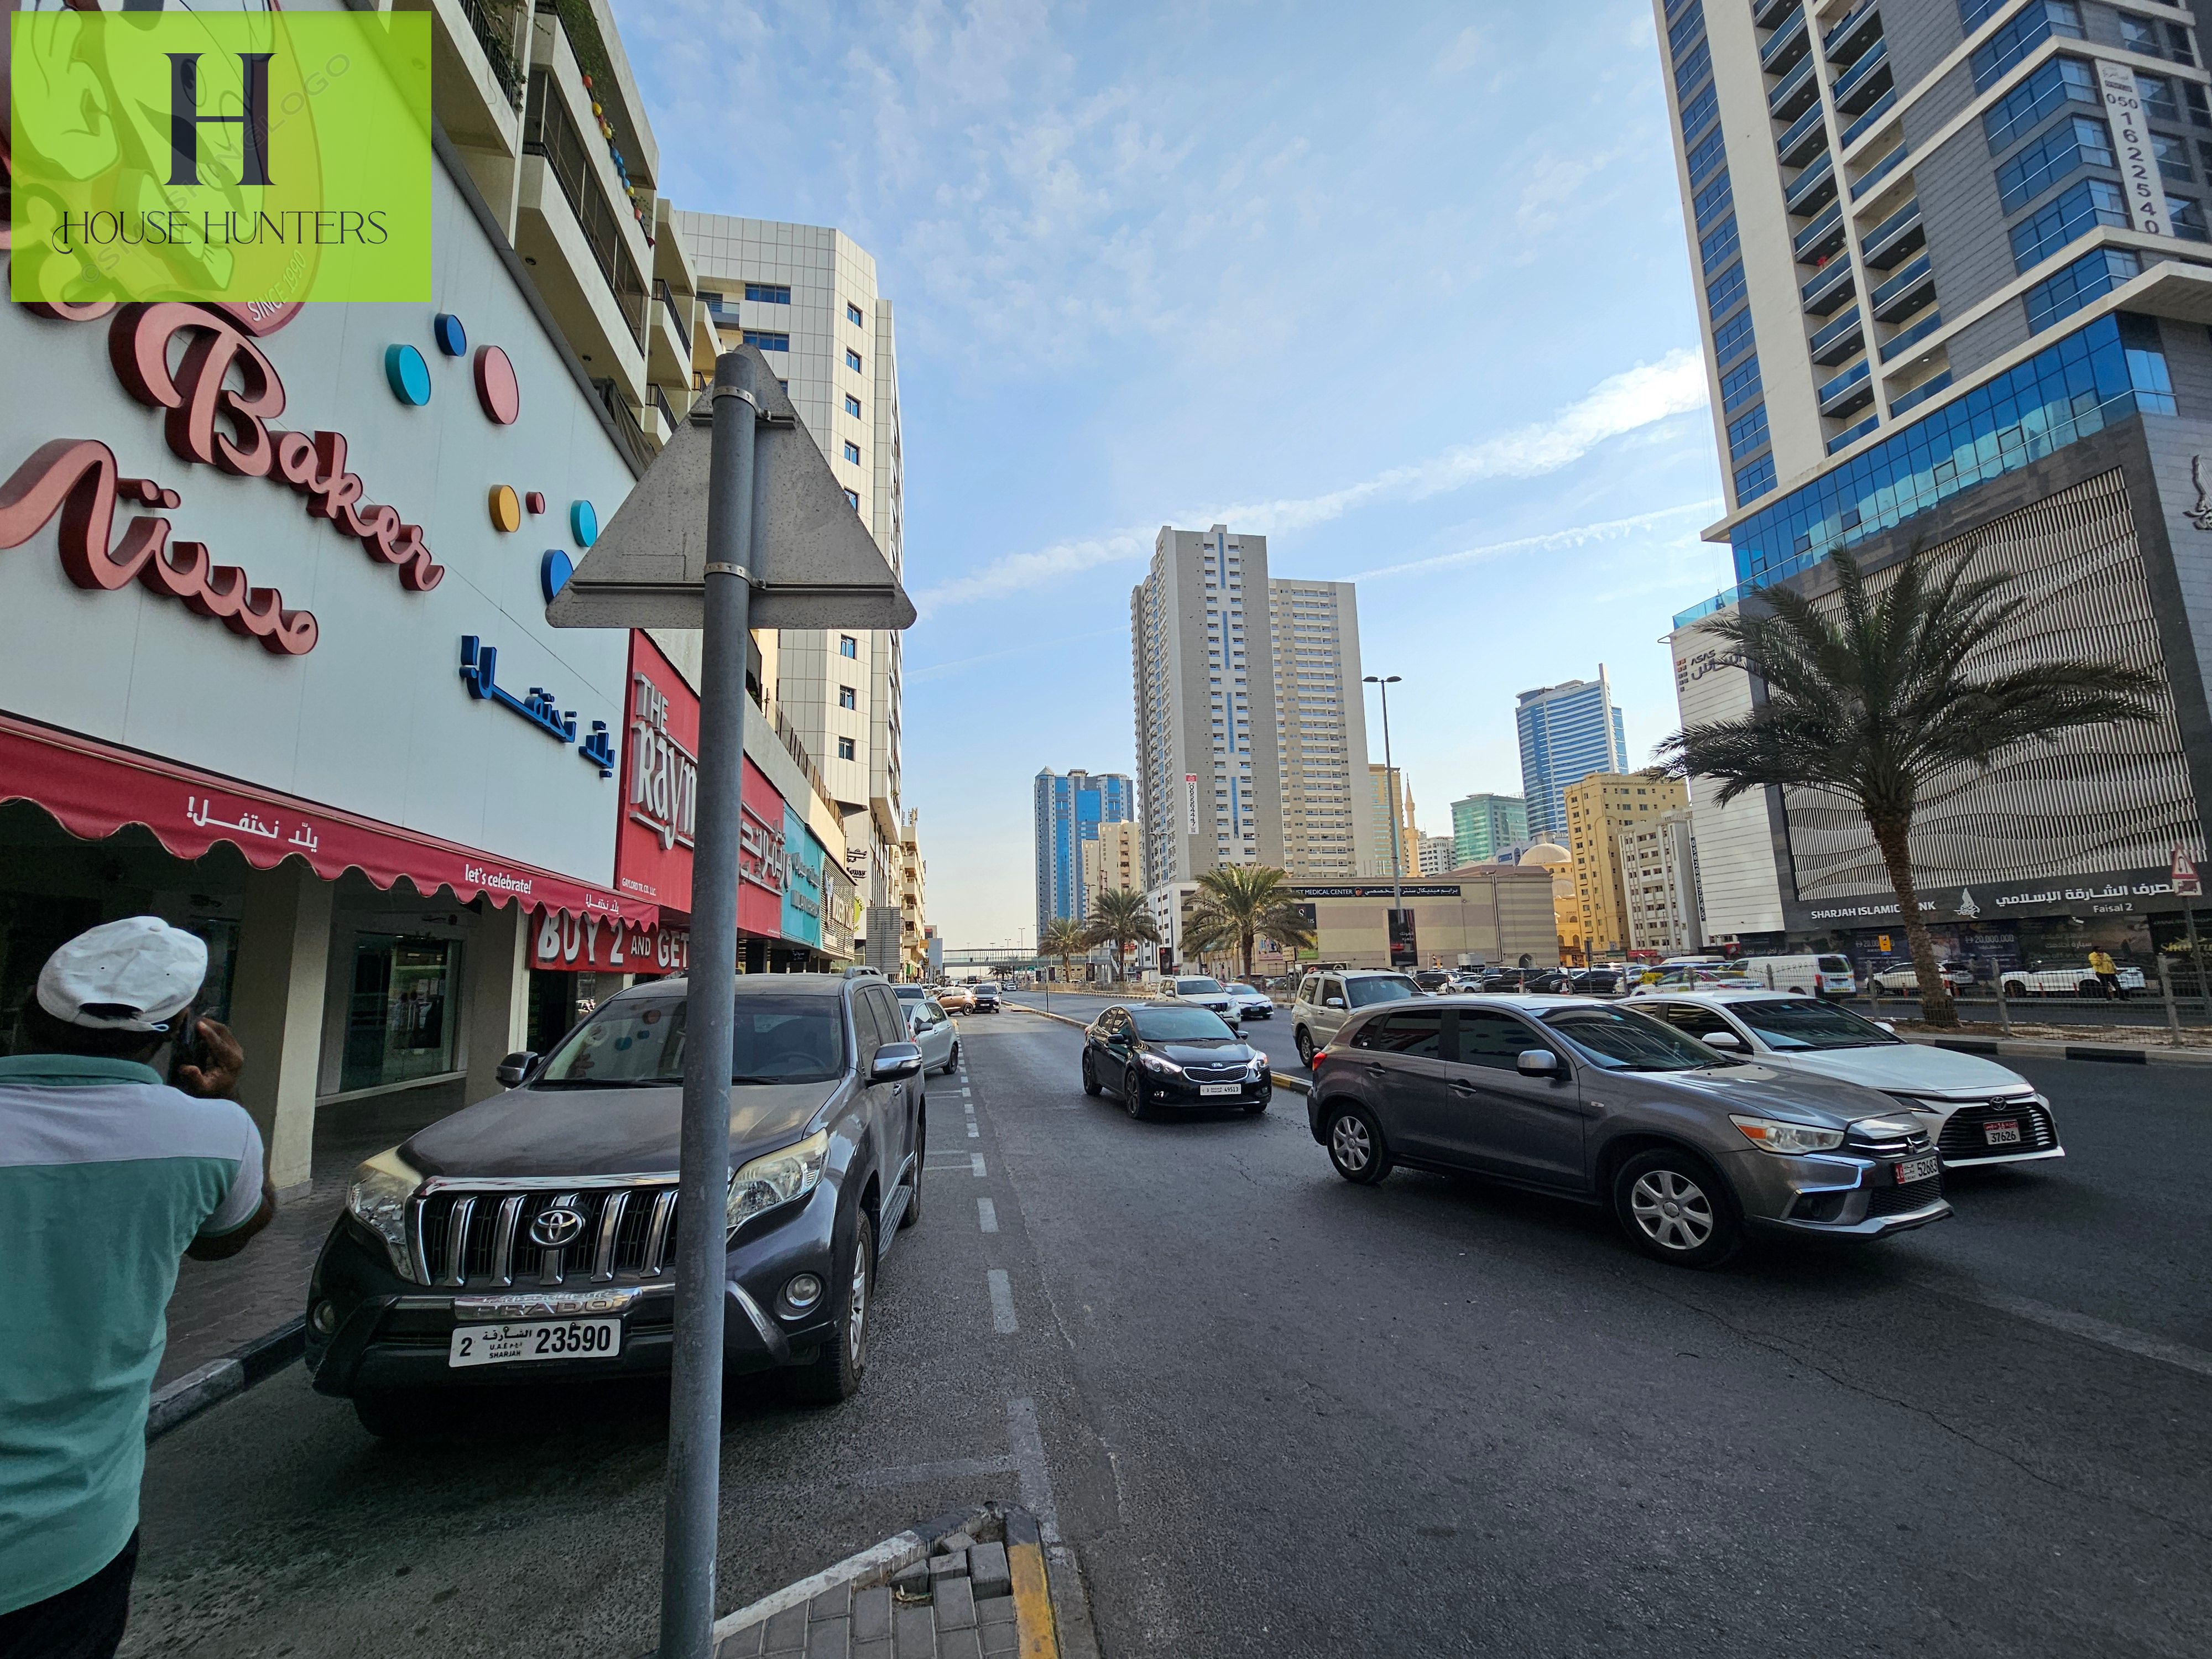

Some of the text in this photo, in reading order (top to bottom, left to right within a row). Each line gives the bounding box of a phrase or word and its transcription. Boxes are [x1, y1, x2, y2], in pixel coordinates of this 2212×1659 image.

[2106, 93, 2138, 109] 050
[247, 248, 306, 322] SINCE 1990
[109, 302, 445, 591] Baker
[634, 671, 669, 735] THE
[465, 863, 532, 895] let's celebrate!
[2065, 883, 2128, 901] الشارقة
[2132, 883, 2174, 896] صرف
[1811, 907, 1856, 919] SHARJAH
[1858, 904, 1901, 916] ISLAMIC
[2093, 902, 2133, 913] Faisal 2
[537, 907, 601, 965] BUY
[609, 918, 624, 967] 2
[630, 935, 651, 958] AND
[1990, 1130, 2016, 1143] 37626
[477, 1298, 614, 1316] PRADO
[460, 1337, 473, 1357] 2
[535, 1325, 611, 1354] 23590
[489, 1350, 521, 1359] SHARJAH
